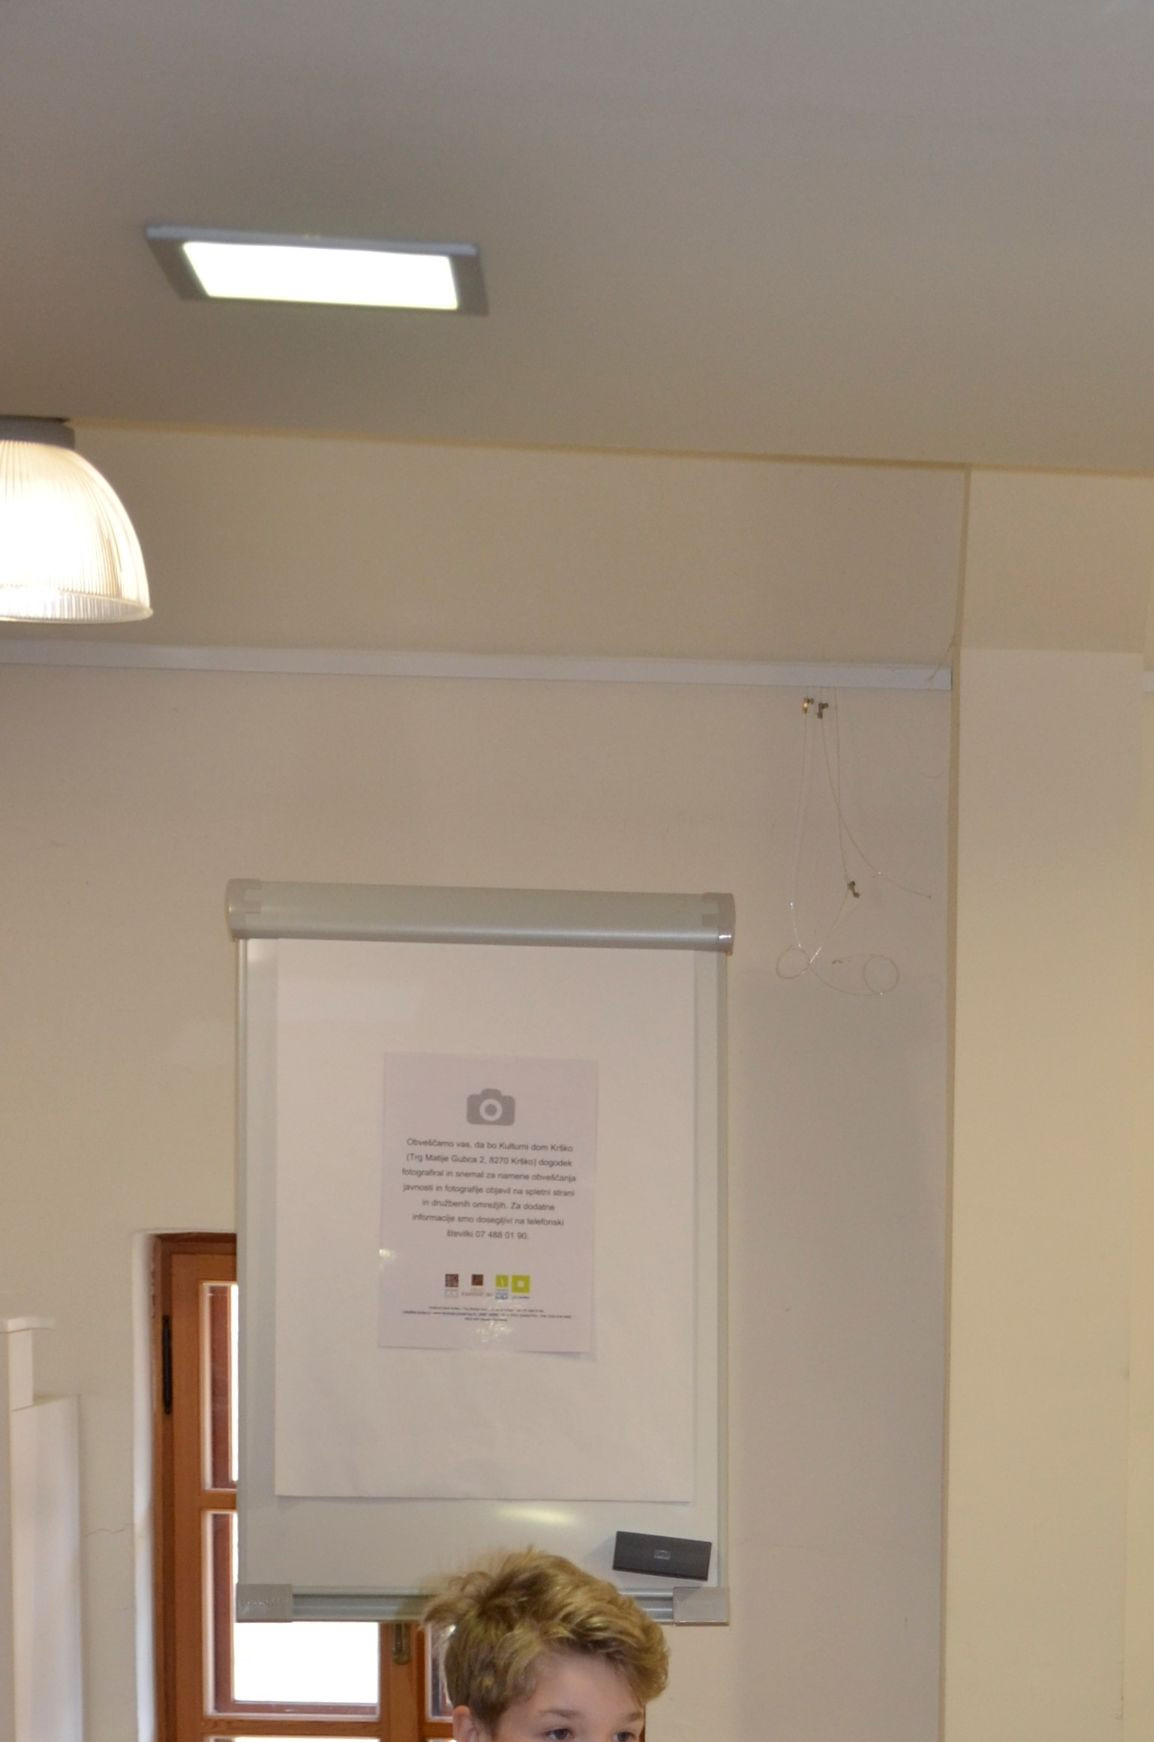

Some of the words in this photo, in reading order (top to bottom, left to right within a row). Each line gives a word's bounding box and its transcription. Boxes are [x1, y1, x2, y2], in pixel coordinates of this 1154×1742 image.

[474, 1140, 485, 1149] da
[486, 1141, 498, 1150] bo
[499, 1141, 529, 1151] Kulturni
[531, 1142, 549, 1152] dom
[550, 1142, 574, 1153] Krško
[406, 1153, 423, 1163] (Trg
[425, 1153, 449, 1163] Matije
[451, 1154, 477, 1164] Gubca
[489, 1156, 508, 1165] 8270
[538, 1158, 573, 1169] dogodek
[446, 1168, 453, 1177] in
[497, 1172, 530, 1181] namene
[402, 1183, 434, 1193] javnosti
[435, 1184, 443, 1193] in
[513, 1187, 523, 1195] na
[525, 1186, 551, 1197] spletni
[552, 1188, 575, 1197] strani
[422, 1199, 429, 1207] in
[510, 1201, 521, 1210] Za
[523, 1202, 556, 1212] dodatne
[411, 1212, 456, 1223] informacije
[457, 1215, 474, 1224] smo
[514, 1217, 525, 1225] na
[526, 1217, 565, 1227] telefonski
[475, 1230, 486, 1238] 07
[488, 1230, 503, 1239] 488
[504, 1231, 514, 1240] 01
